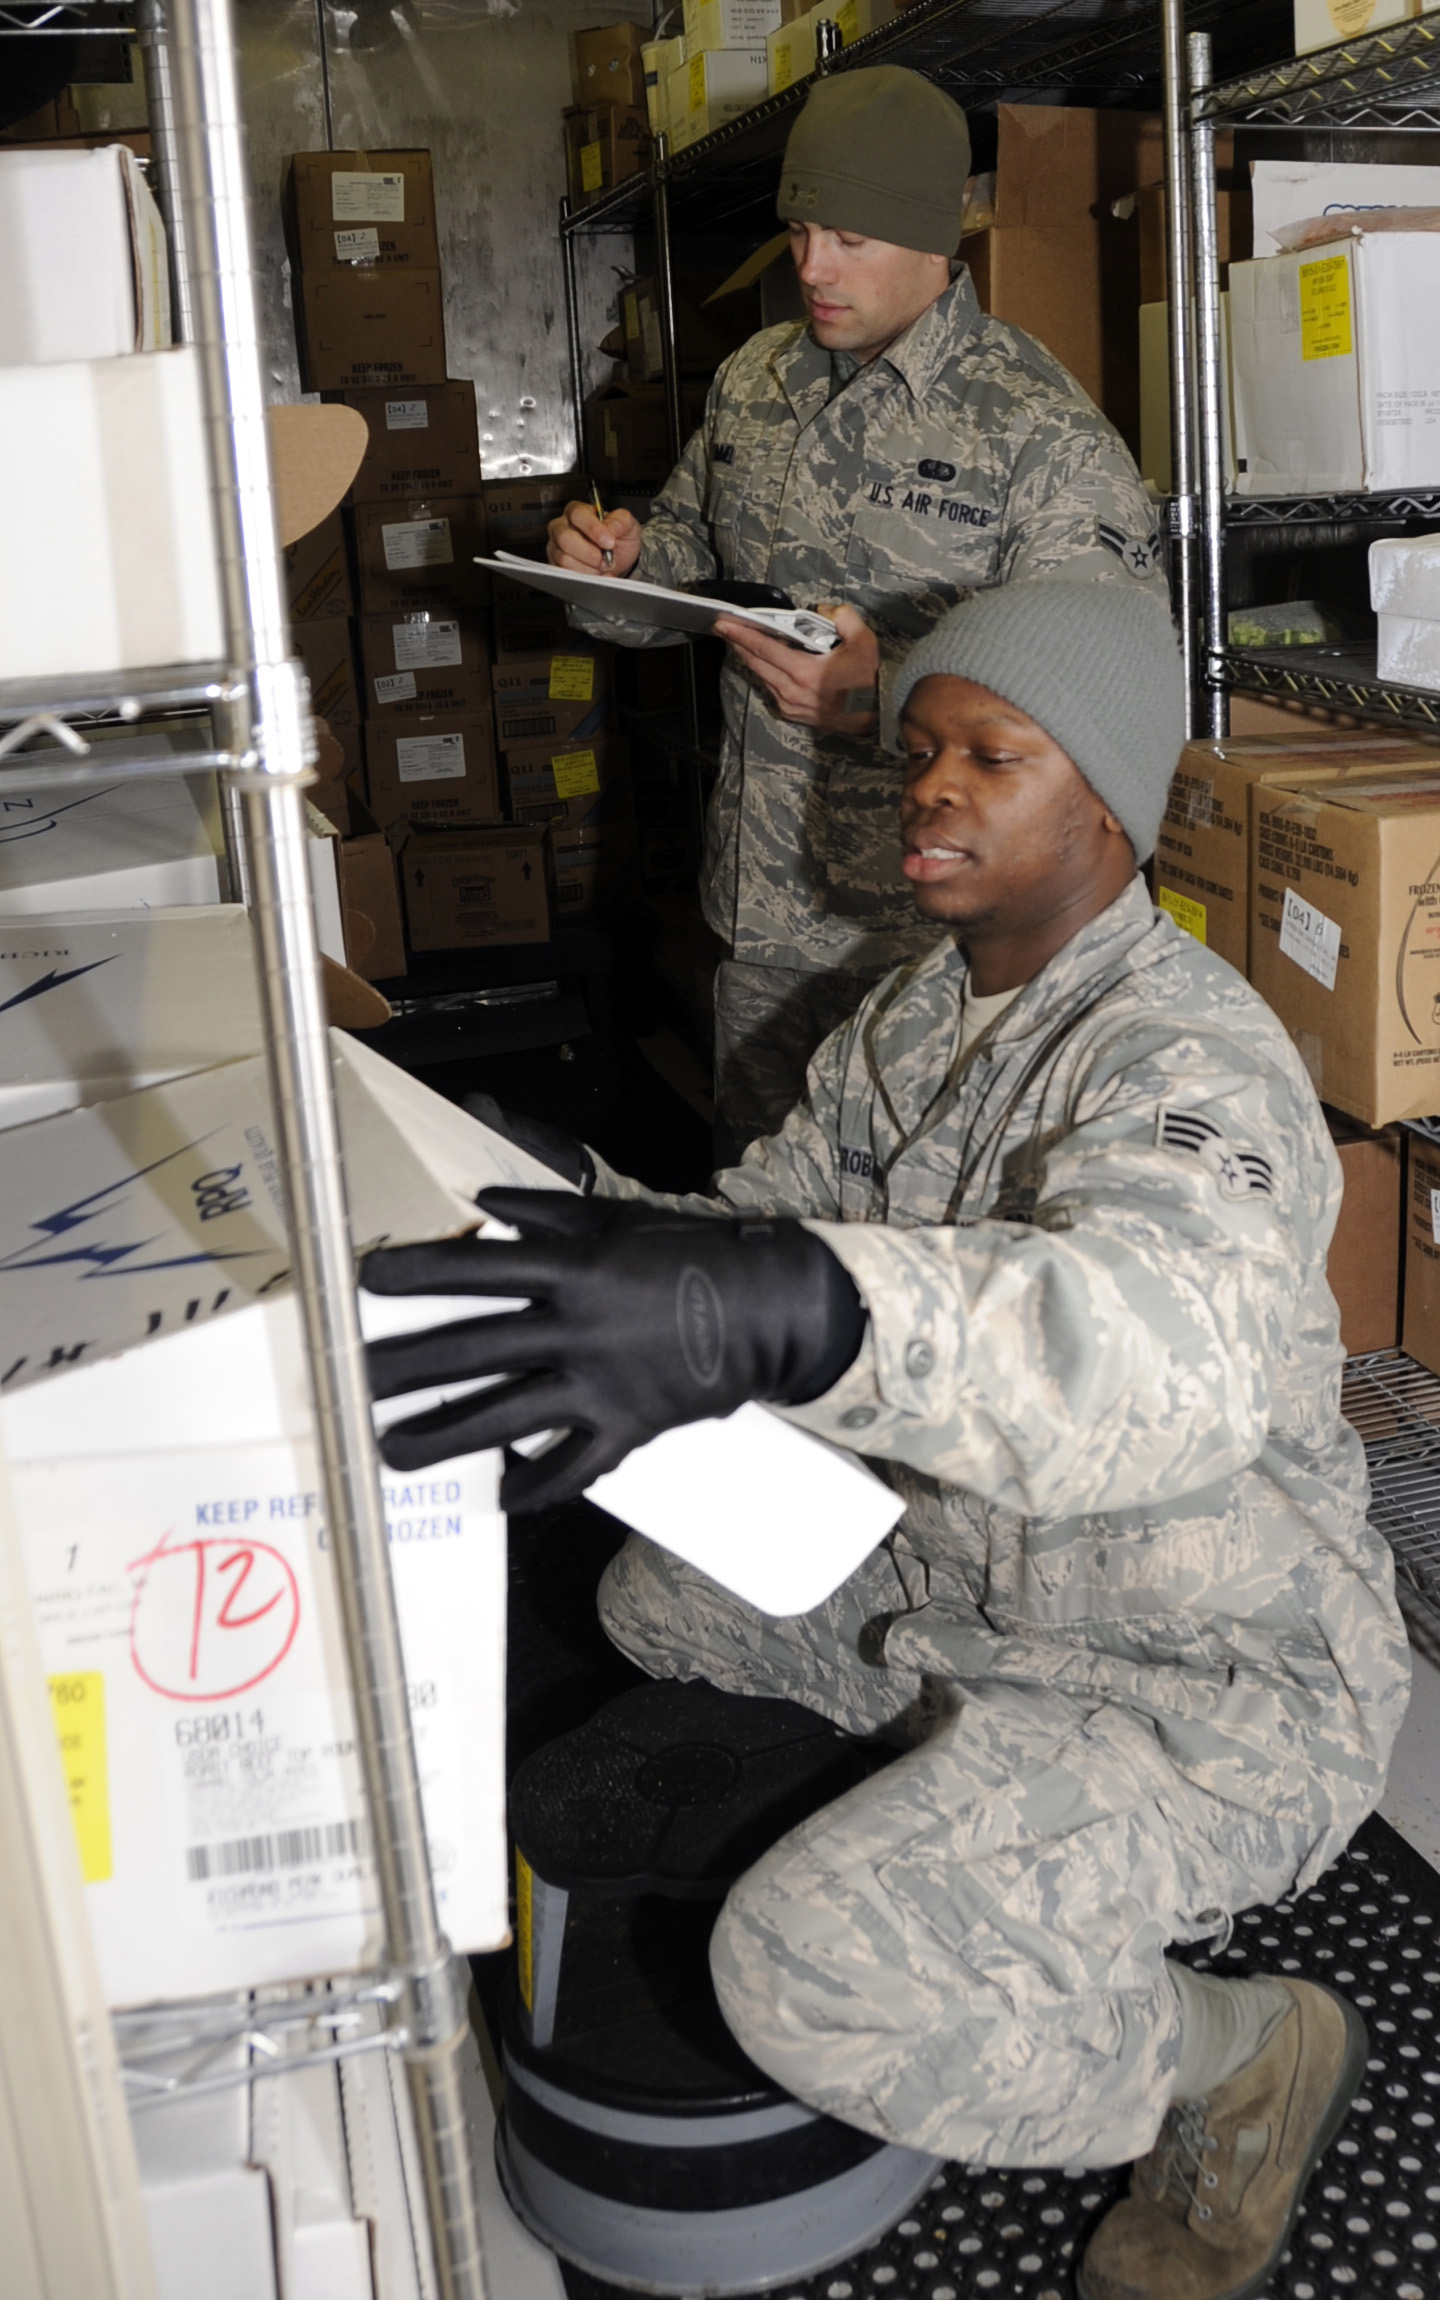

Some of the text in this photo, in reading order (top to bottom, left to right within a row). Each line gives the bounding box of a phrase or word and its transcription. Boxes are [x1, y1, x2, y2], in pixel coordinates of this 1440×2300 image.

[870, 482, 992, 527] U.S. AIR FORCE
[190, 1161, 252, 1223] RPQ
[195, 1499, 260, 1526] KEEP
